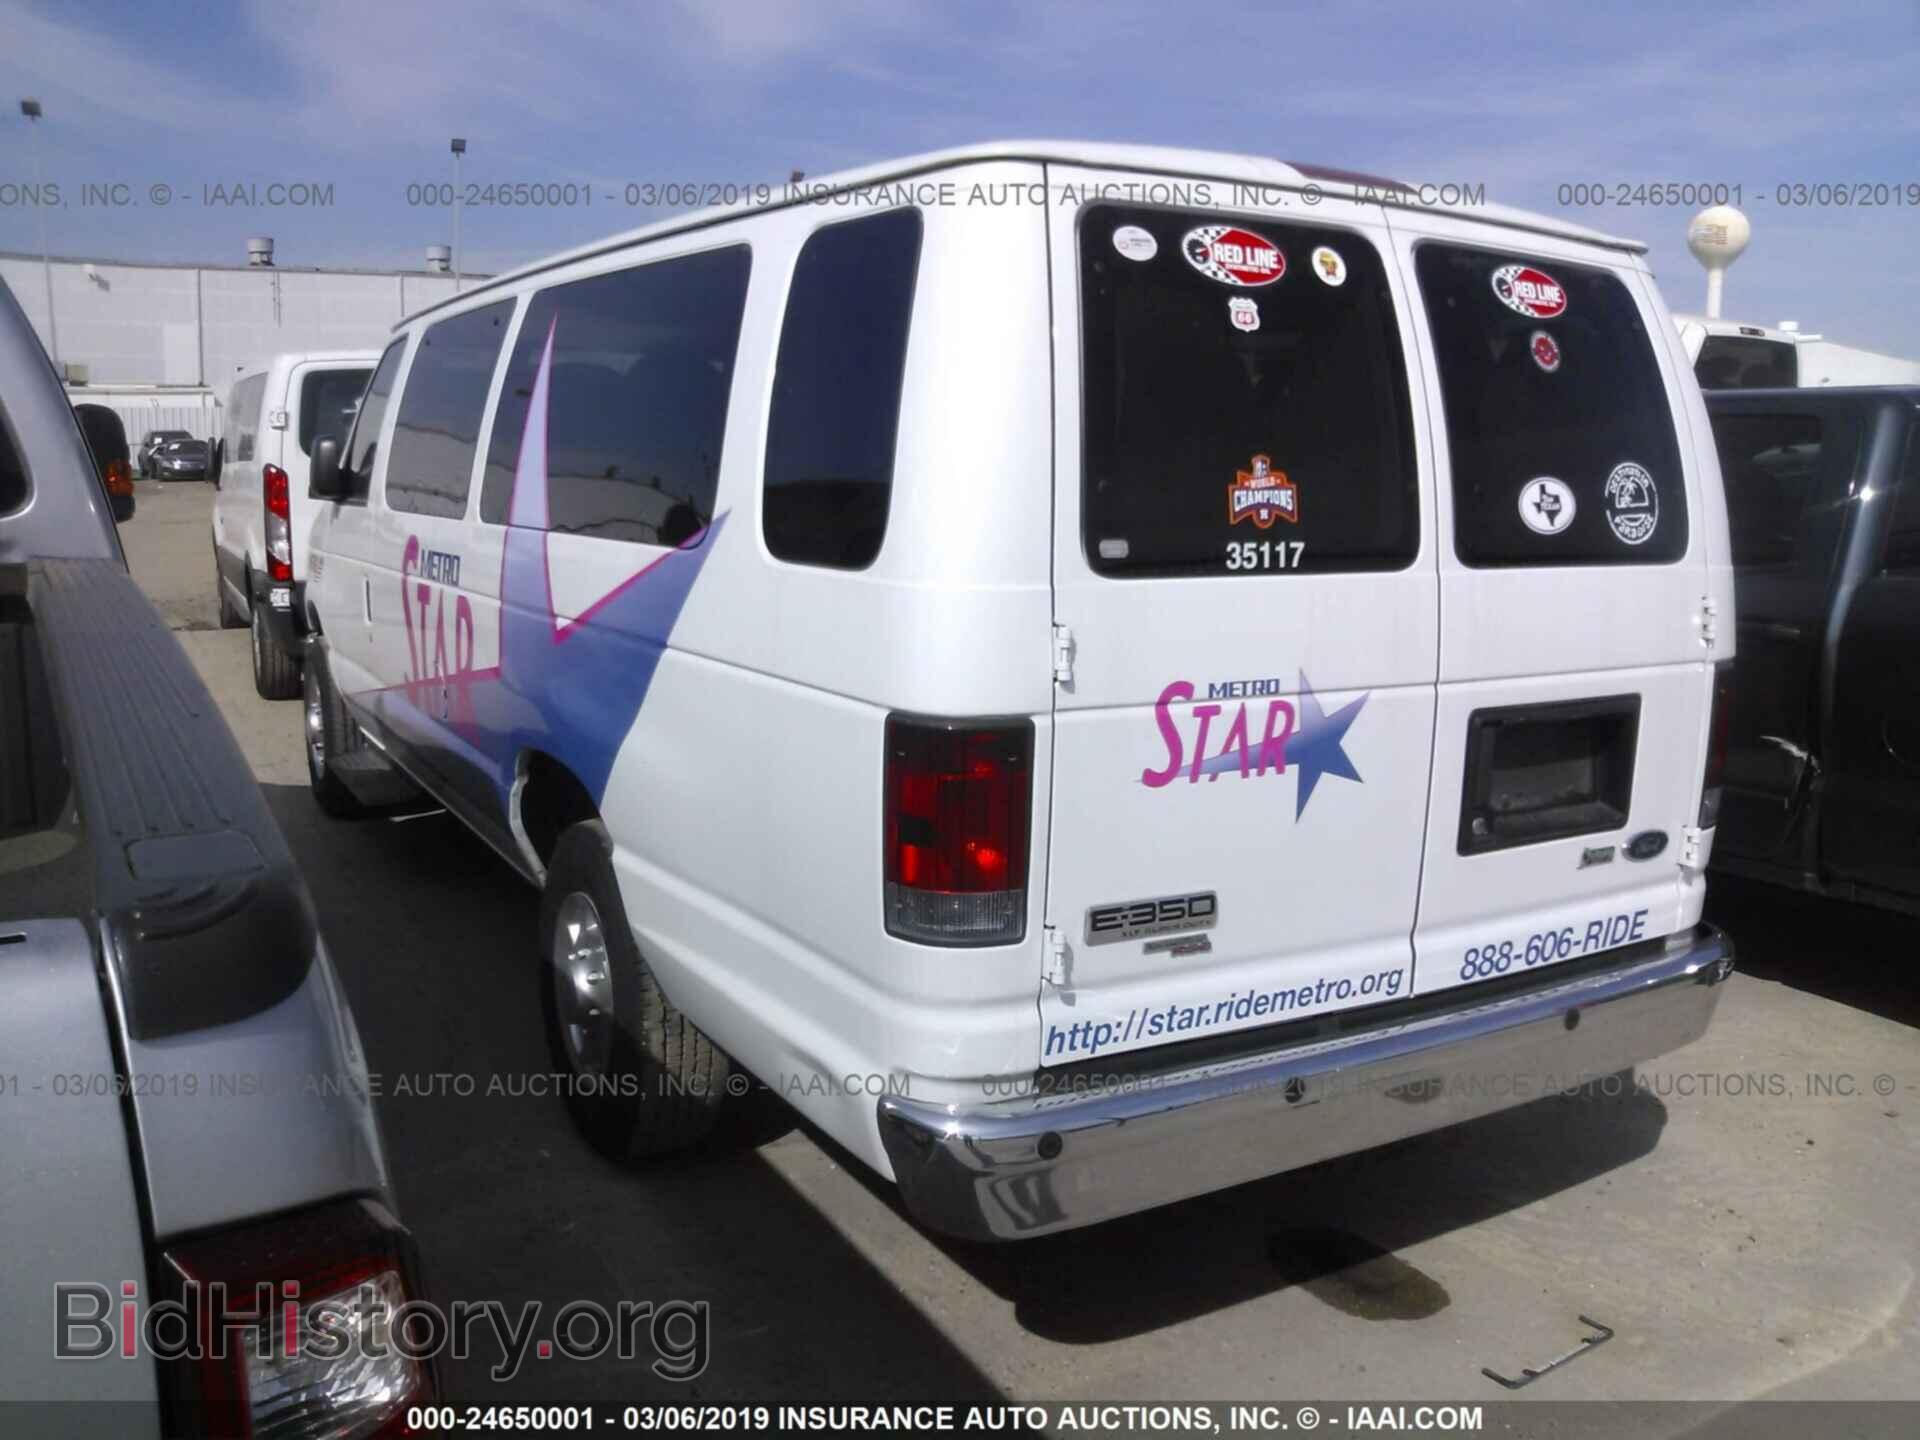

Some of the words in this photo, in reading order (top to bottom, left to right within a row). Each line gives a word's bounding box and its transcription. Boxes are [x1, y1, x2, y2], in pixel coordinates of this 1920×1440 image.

[1213, 243, 1244, 264] RED
[1245, 246, 1281, 269] LINE
[1513, 280, 1537, 299] RED
[1537, 283, 1563, 303] LINE
[1233, 488, 1294, 512] CHAMPIONS
[421, 548, 461, 586] METRO
[1225, 541, 1305, 570] 35117
[1208, 678, 1281, 699] METRO
[1142, 680, 1296, 788] STAR
[1091, 894, 1215, 932] E-350
[1460, 909, 1649, 981] 888-606-RIDE
[1045, 968, 1404, 1056] http://star.ridemetro.org
